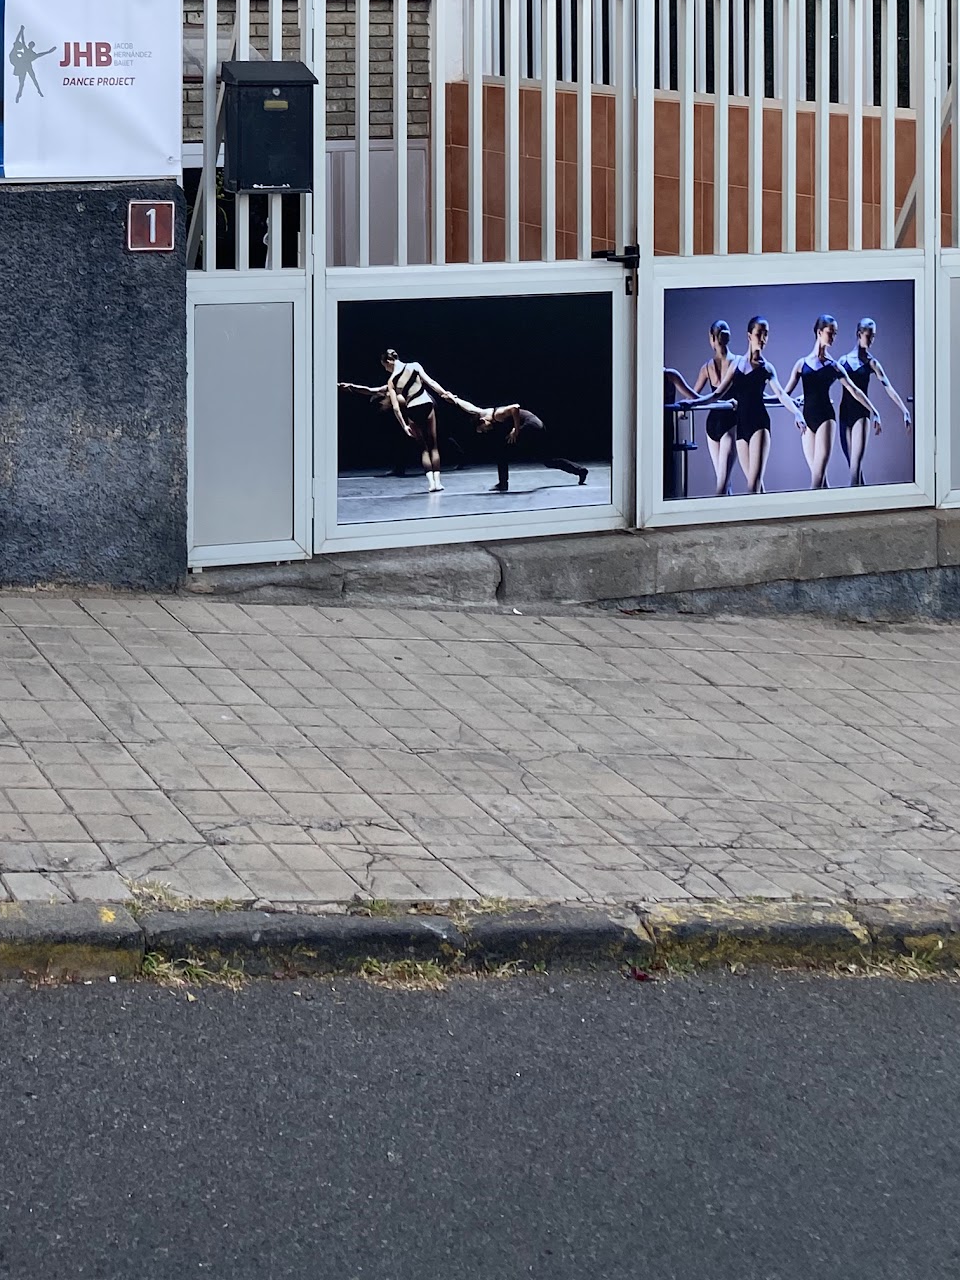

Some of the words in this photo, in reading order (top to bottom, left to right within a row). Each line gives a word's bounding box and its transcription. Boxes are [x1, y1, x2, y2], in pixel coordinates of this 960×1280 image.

[59, 42, 113, 68] JHB
[62, 77, 95, 86] DANCE
[97, 77, 136, 86] PROJECT
[145, 208, 157, 244] 1
